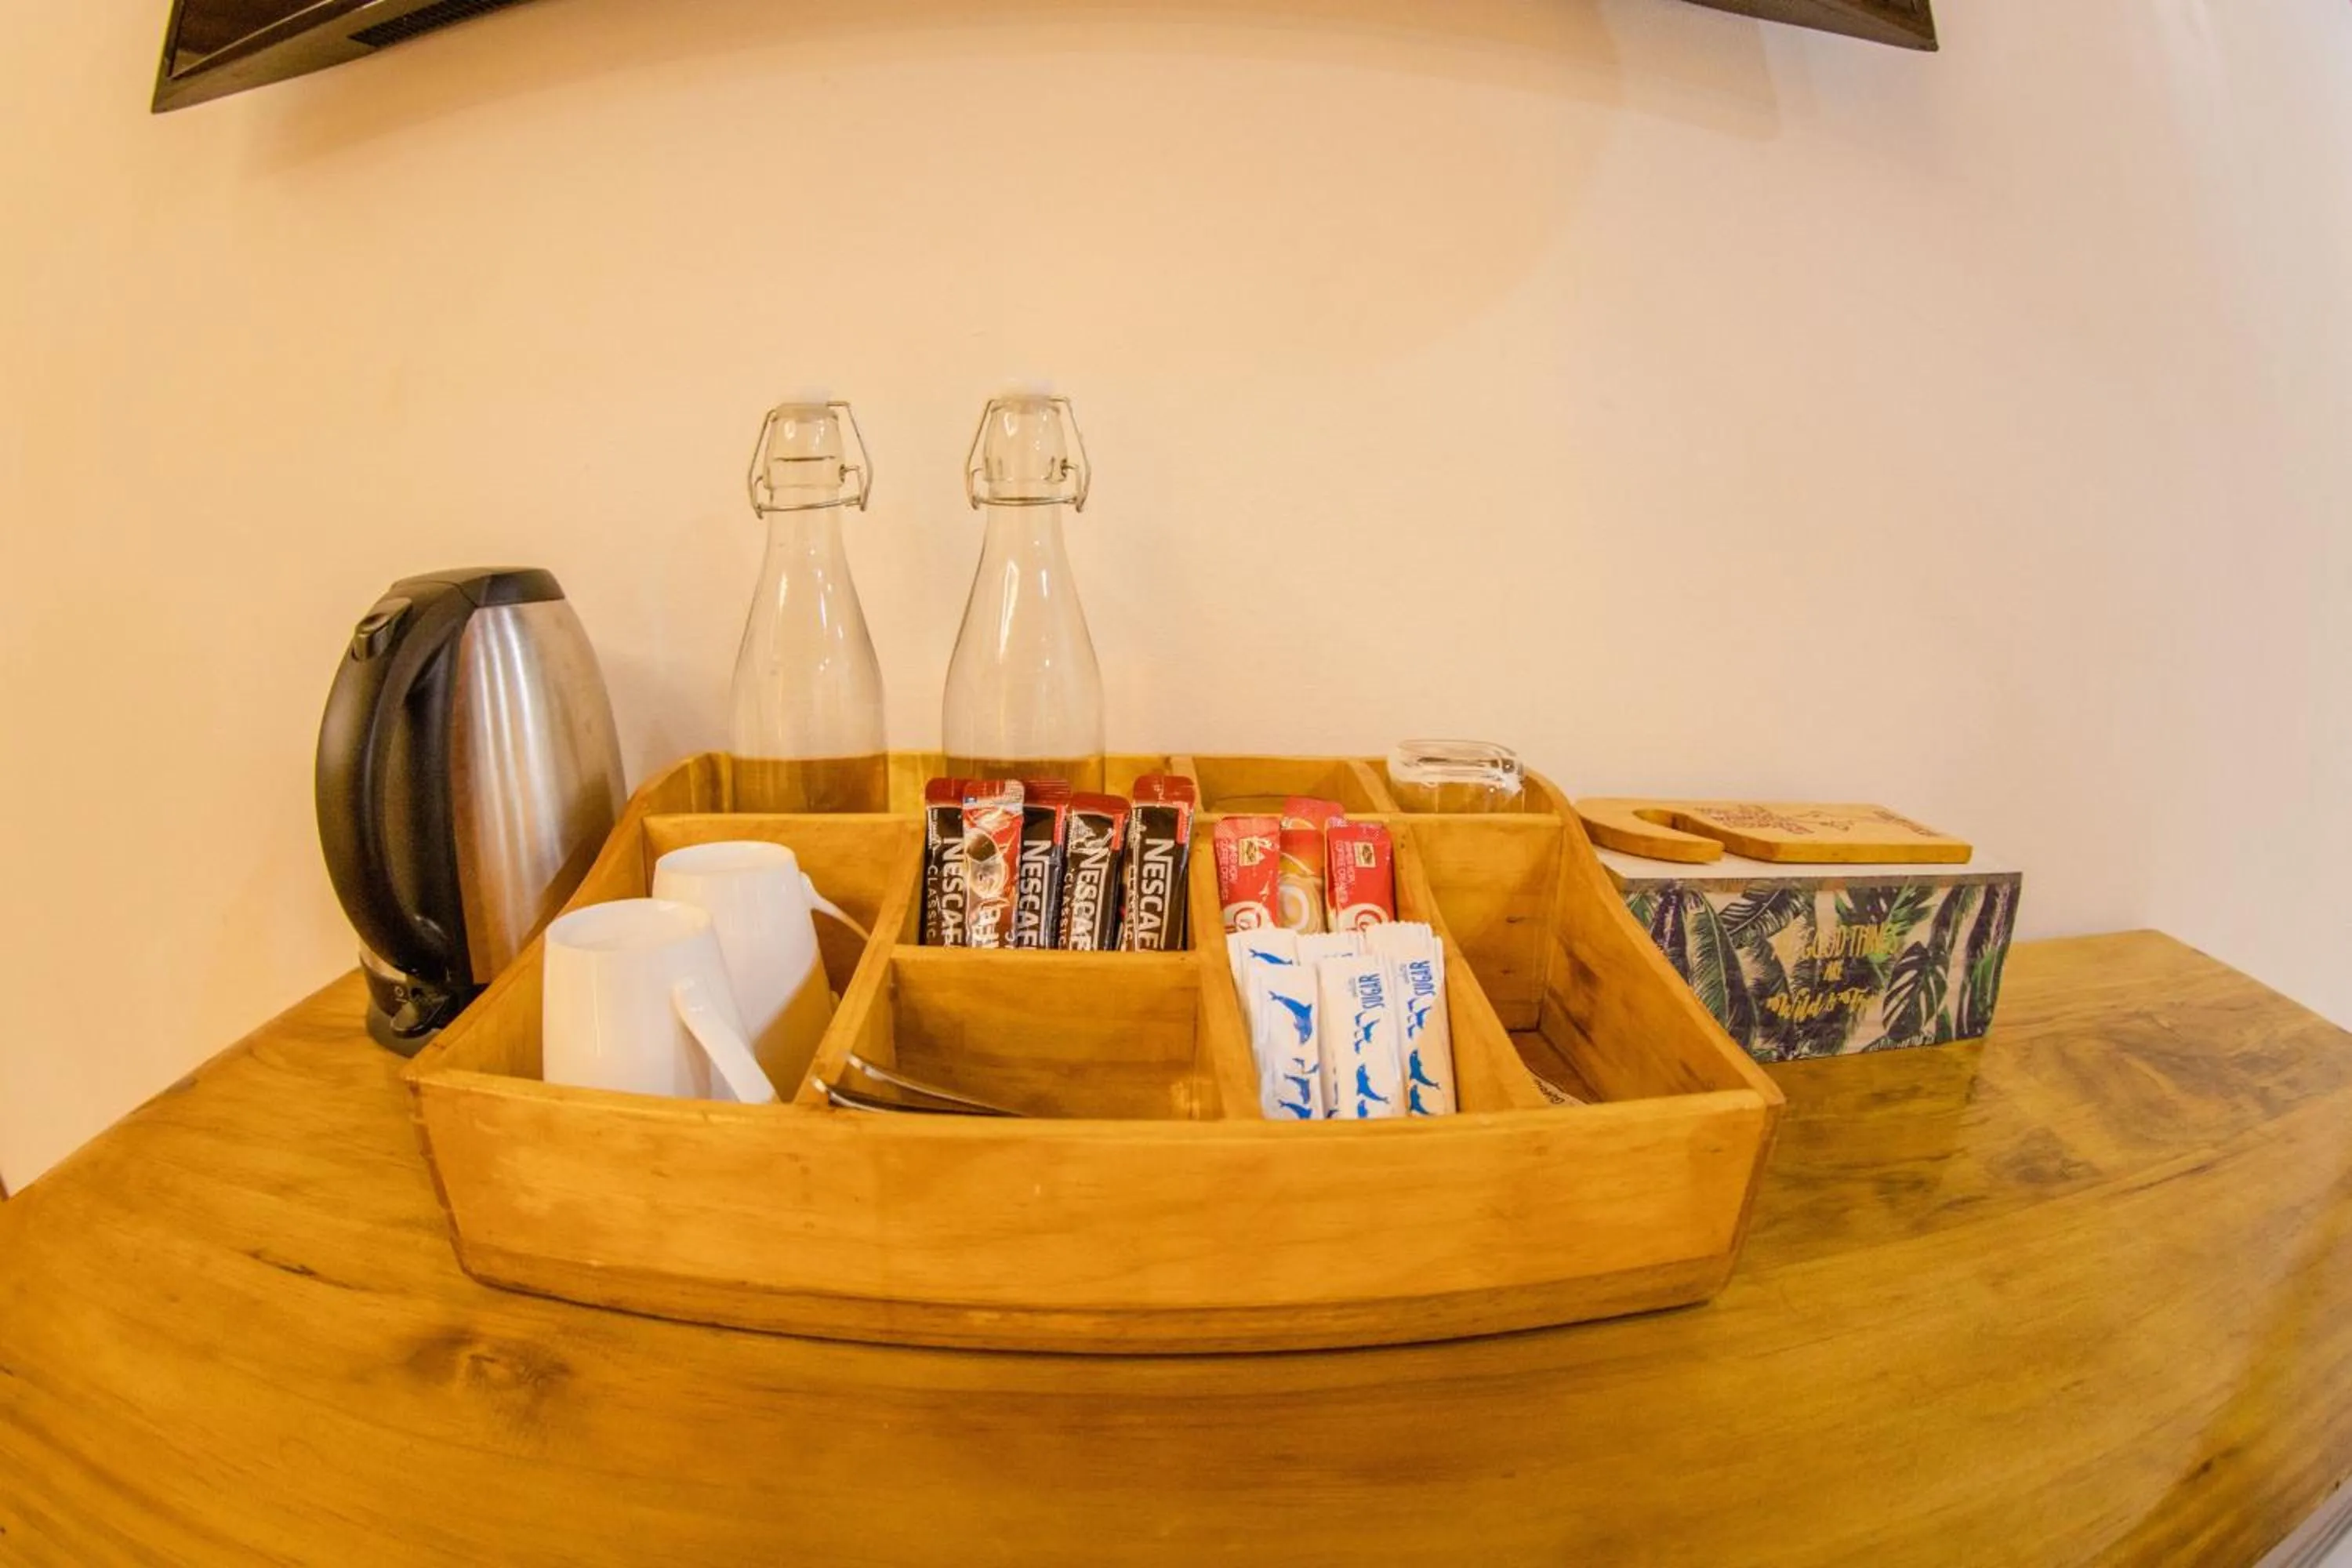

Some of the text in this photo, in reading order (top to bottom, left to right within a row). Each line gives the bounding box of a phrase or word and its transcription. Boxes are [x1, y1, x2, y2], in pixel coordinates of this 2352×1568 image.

[927, 865, 938, 938] CLASSIC
[941, 837, 965, 946] NESCAF
[1017, 840, 1051, 949] NESCAF
[1058, 873, 1074, 946] CLASSIC
[1069, 848, 1110, 951] NESCAF
[1138, 838, 1175, 950] NESCAF
[1359, 973, 1385, 1010] SUGAR
[1409, 960, 1436, 996] SUGAR
